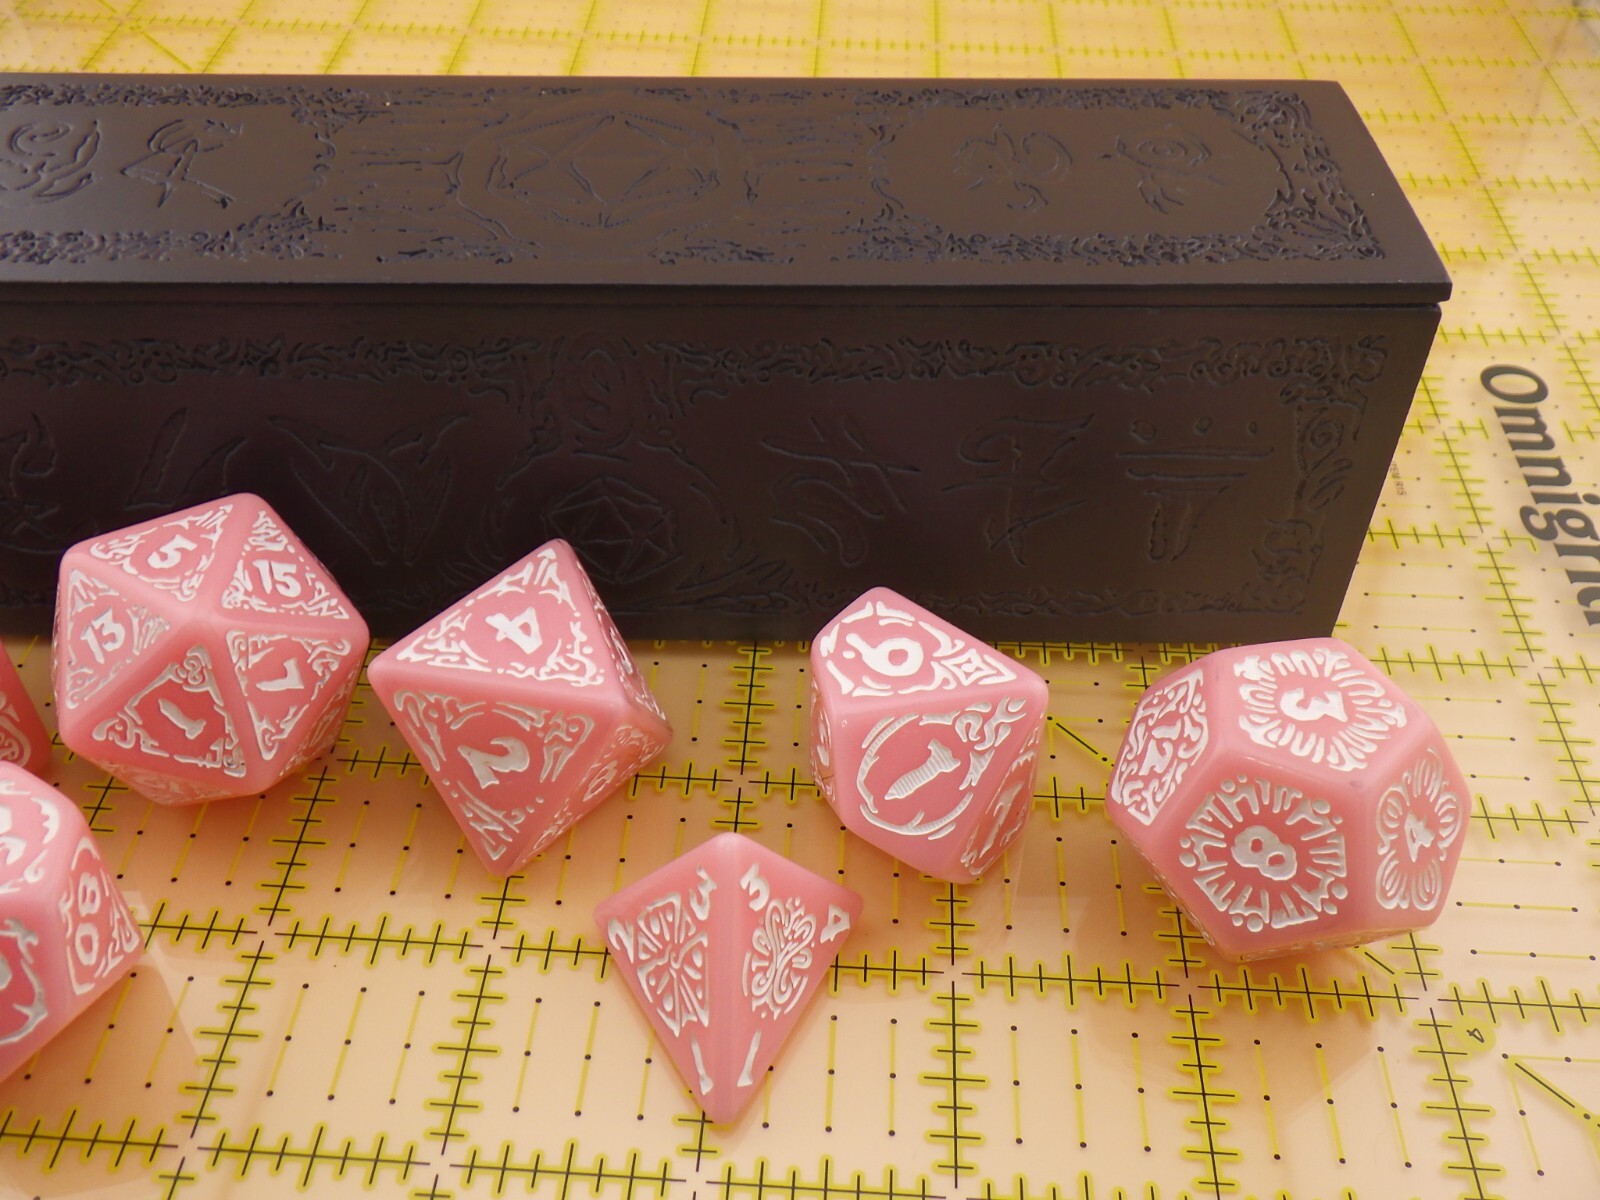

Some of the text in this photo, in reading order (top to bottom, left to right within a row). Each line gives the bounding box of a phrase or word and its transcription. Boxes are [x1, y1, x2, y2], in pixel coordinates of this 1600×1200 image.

[147, 534, 198, 570] 5
[252, 559, 302, 598] 15
[80, 607, 127, 664] 13
[485, 606, 544, 655] 4
[256, 656, 305, 691] 7
[158, 697, 207, 739] 1
[1279, 687, 1348, 723] 3
[457, 737, 531, 789] 2
[884, 738, 962, 800] 1
[1231, 825, 1298, 881] 8
[1403, 812, 1436, 863] 4
[689, 864, 718, 921] 3
[739, 862, 771, 912] 3
[74, 871, 101, 967] 80
[819, 903, 852, 944] 4
[736, 1028, 762, 1087] 1
[1466, 1027, 1486, 1043] 4
[690, 1030, 714, 1096] 1
